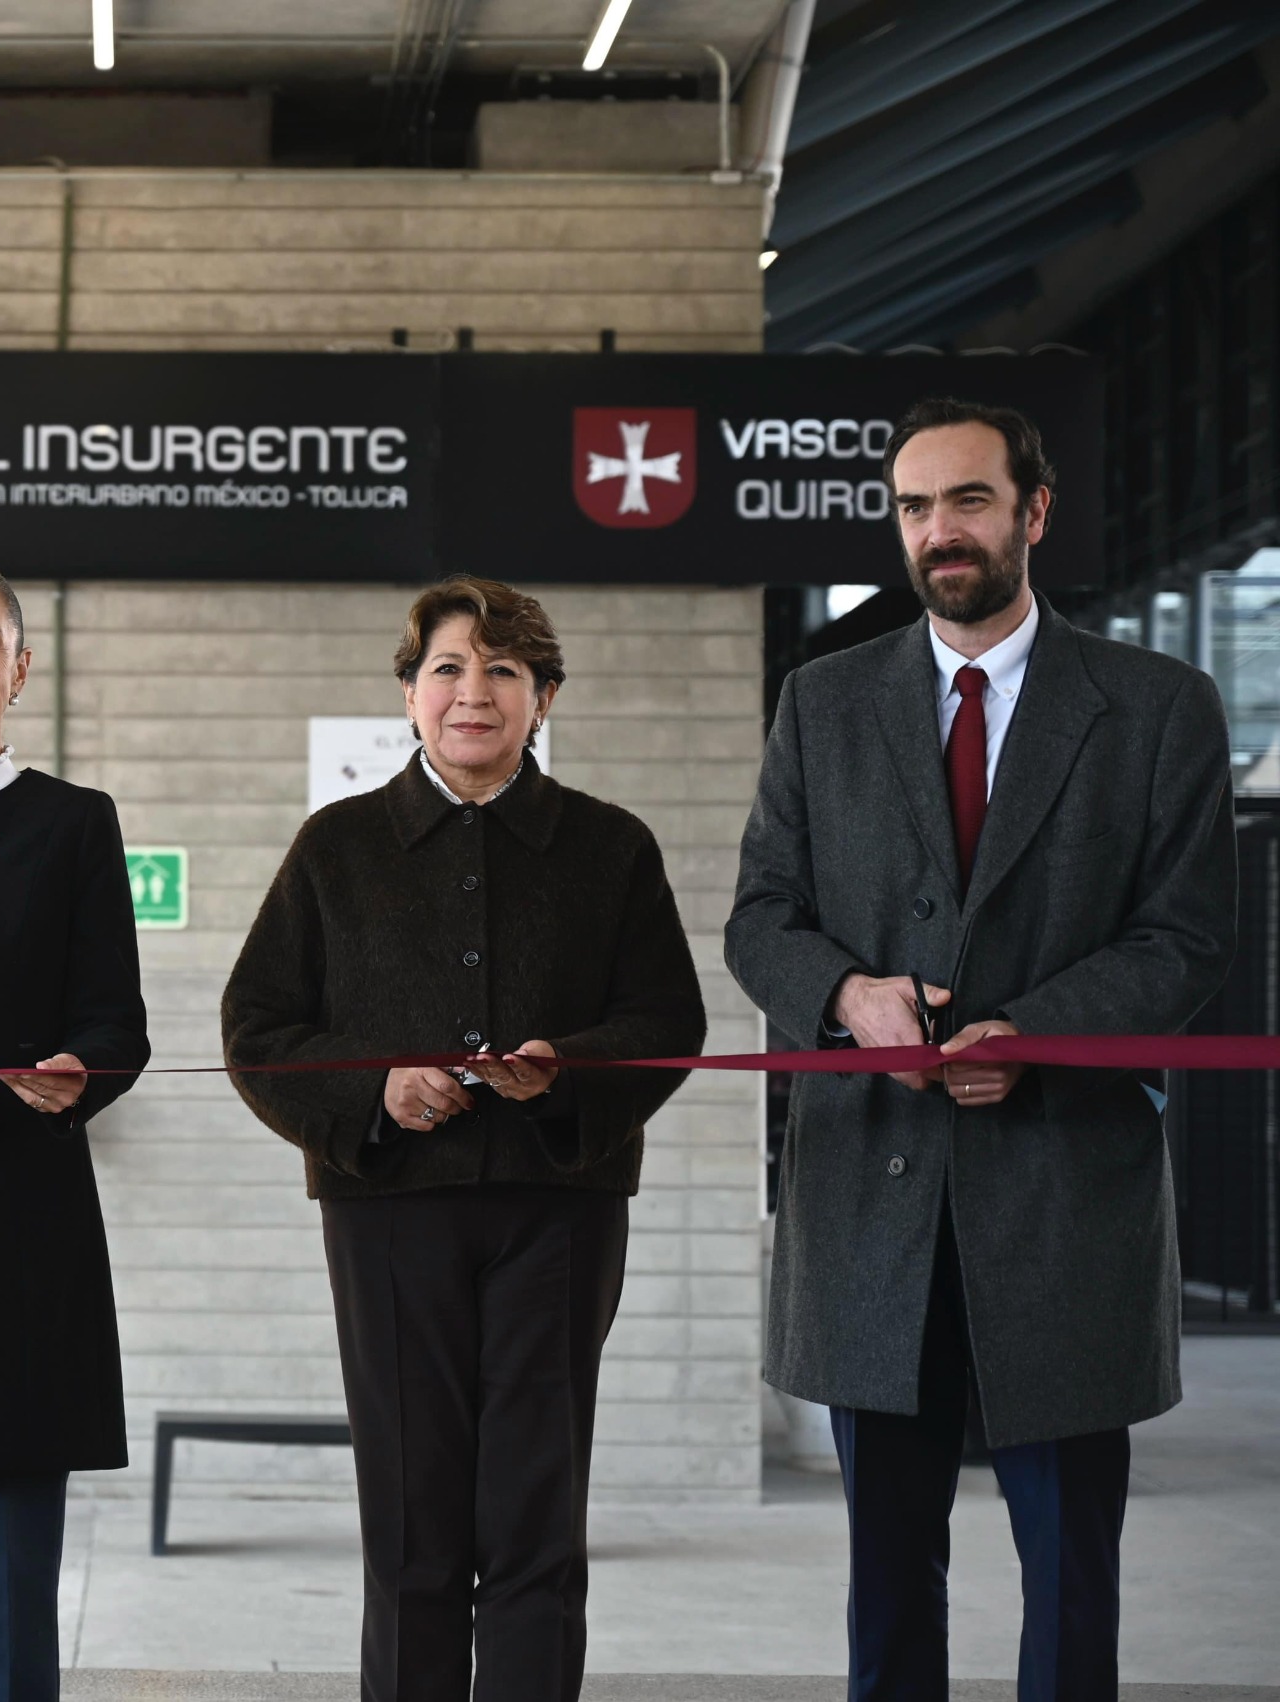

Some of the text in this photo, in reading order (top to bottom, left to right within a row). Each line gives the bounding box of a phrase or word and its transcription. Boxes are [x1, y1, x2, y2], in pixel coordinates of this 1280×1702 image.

[23, 424, 408, 473] INSURGENTE
[720, 418, 893, 460] VASCO
[9, 482, 190, 507] INTERURBANO
[193, 479, 290, 508] MÉXICO
[736, 478, 890, 520] QUIRO
